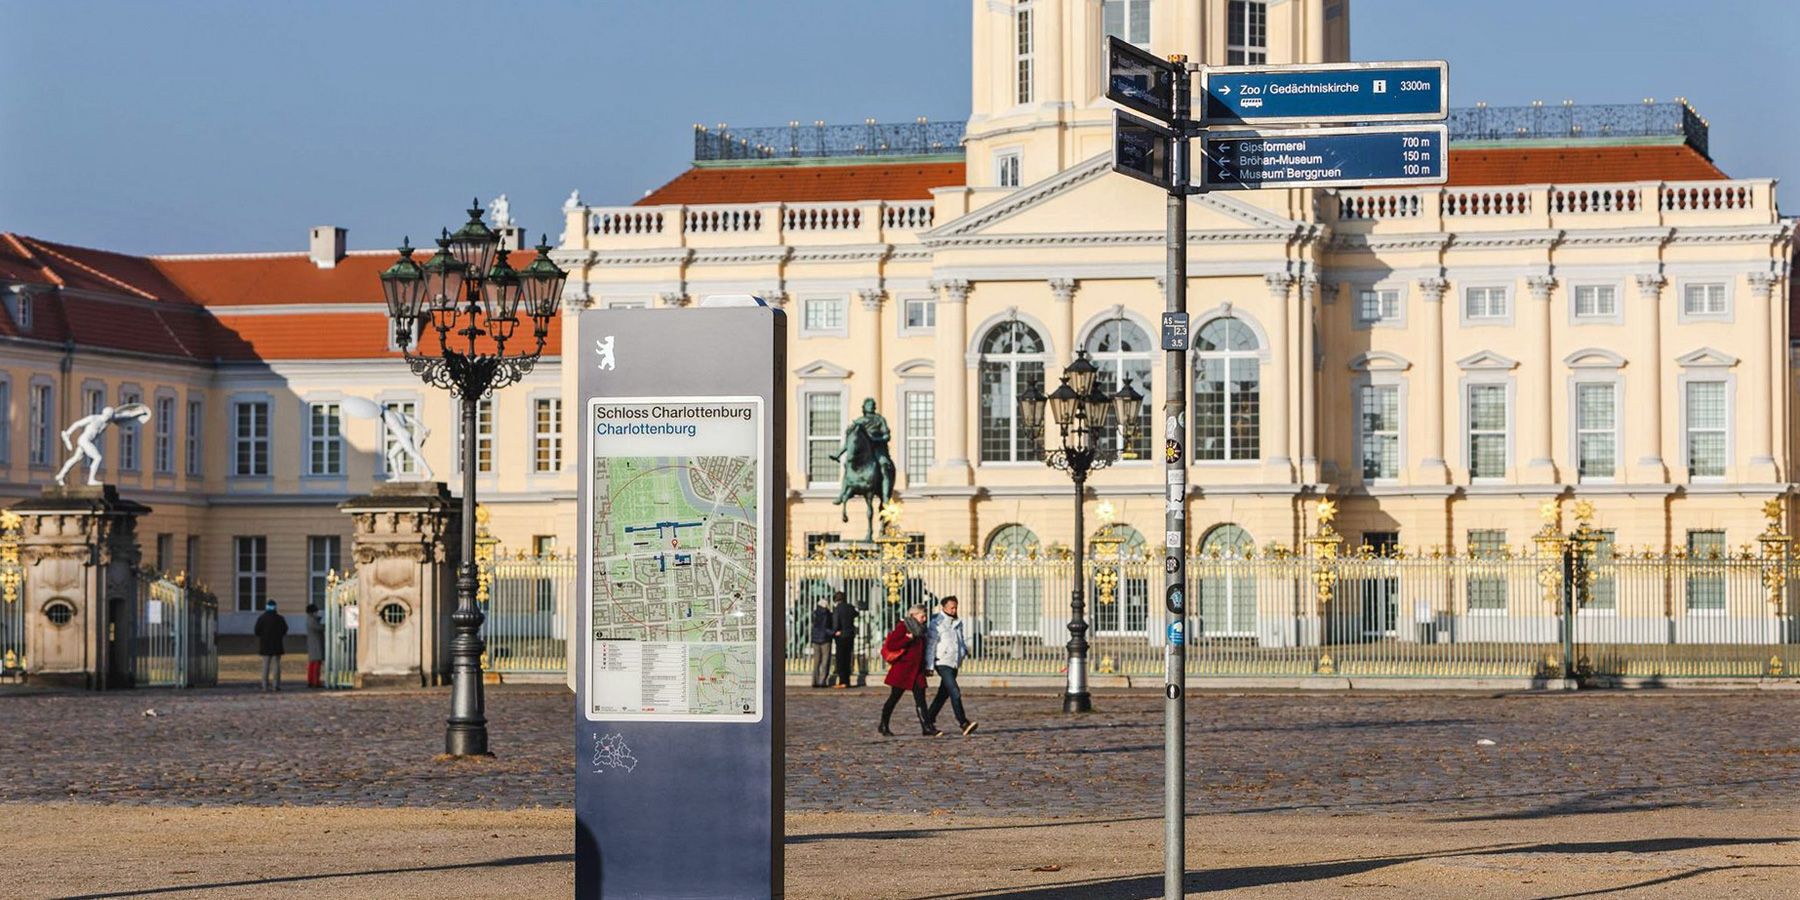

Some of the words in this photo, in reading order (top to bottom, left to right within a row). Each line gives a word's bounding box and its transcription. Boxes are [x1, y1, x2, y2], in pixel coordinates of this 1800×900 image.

[1240, 85, 1260, 95] Zoo
[1269, 83, 1359, 95] Gedächtniskirche
[1400, 80, 1431, 91] 3300m
[1240, 141, 1306, 154] Gipsformerei
[1402, 137, 1419, 147] 700
[1421, 138, 1430, 147] m
[1240, 155, 1323, 166] Bröhan-Museum
[1403, 150, 1420, 161] 150
[1421, 152, 1430, 160] m
[1240, 169, 1284, 179] Museum
[1286, 167, 1341, 180] Berggruen
[1403, 164, 1420, 175] 100
[1421, 166, 1430, 174] m
[597, 407, 649, 419] Schloss
[651, 406, 752, 421] Charlottenburg
[596, 423, 696, 437] Charlottenburg
